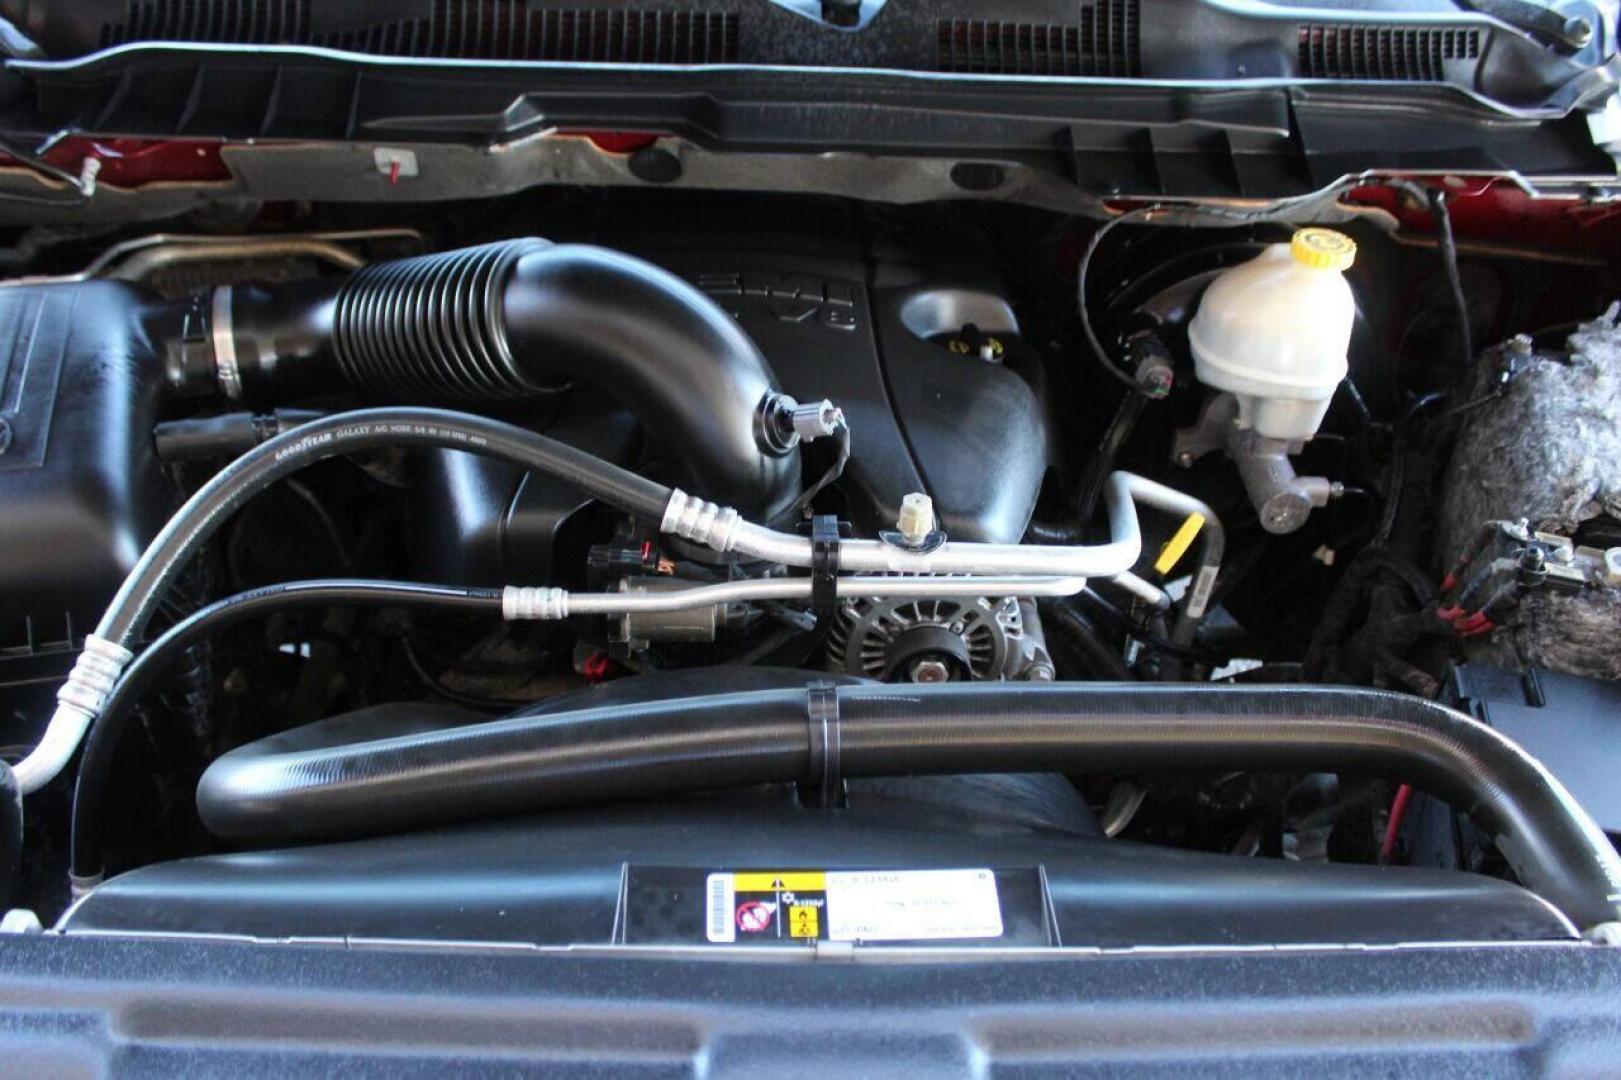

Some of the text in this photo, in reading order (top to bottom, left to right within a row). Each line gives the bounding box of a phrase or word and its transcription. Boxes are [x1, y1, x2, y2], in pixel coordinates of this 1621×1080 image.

[275, 432, 333, 461] GOODYEAR
[336, 425, 370, 438] GALAXY
[375, 424, 388, 433] A/C
[390, 424, 412, 433] HOSE
